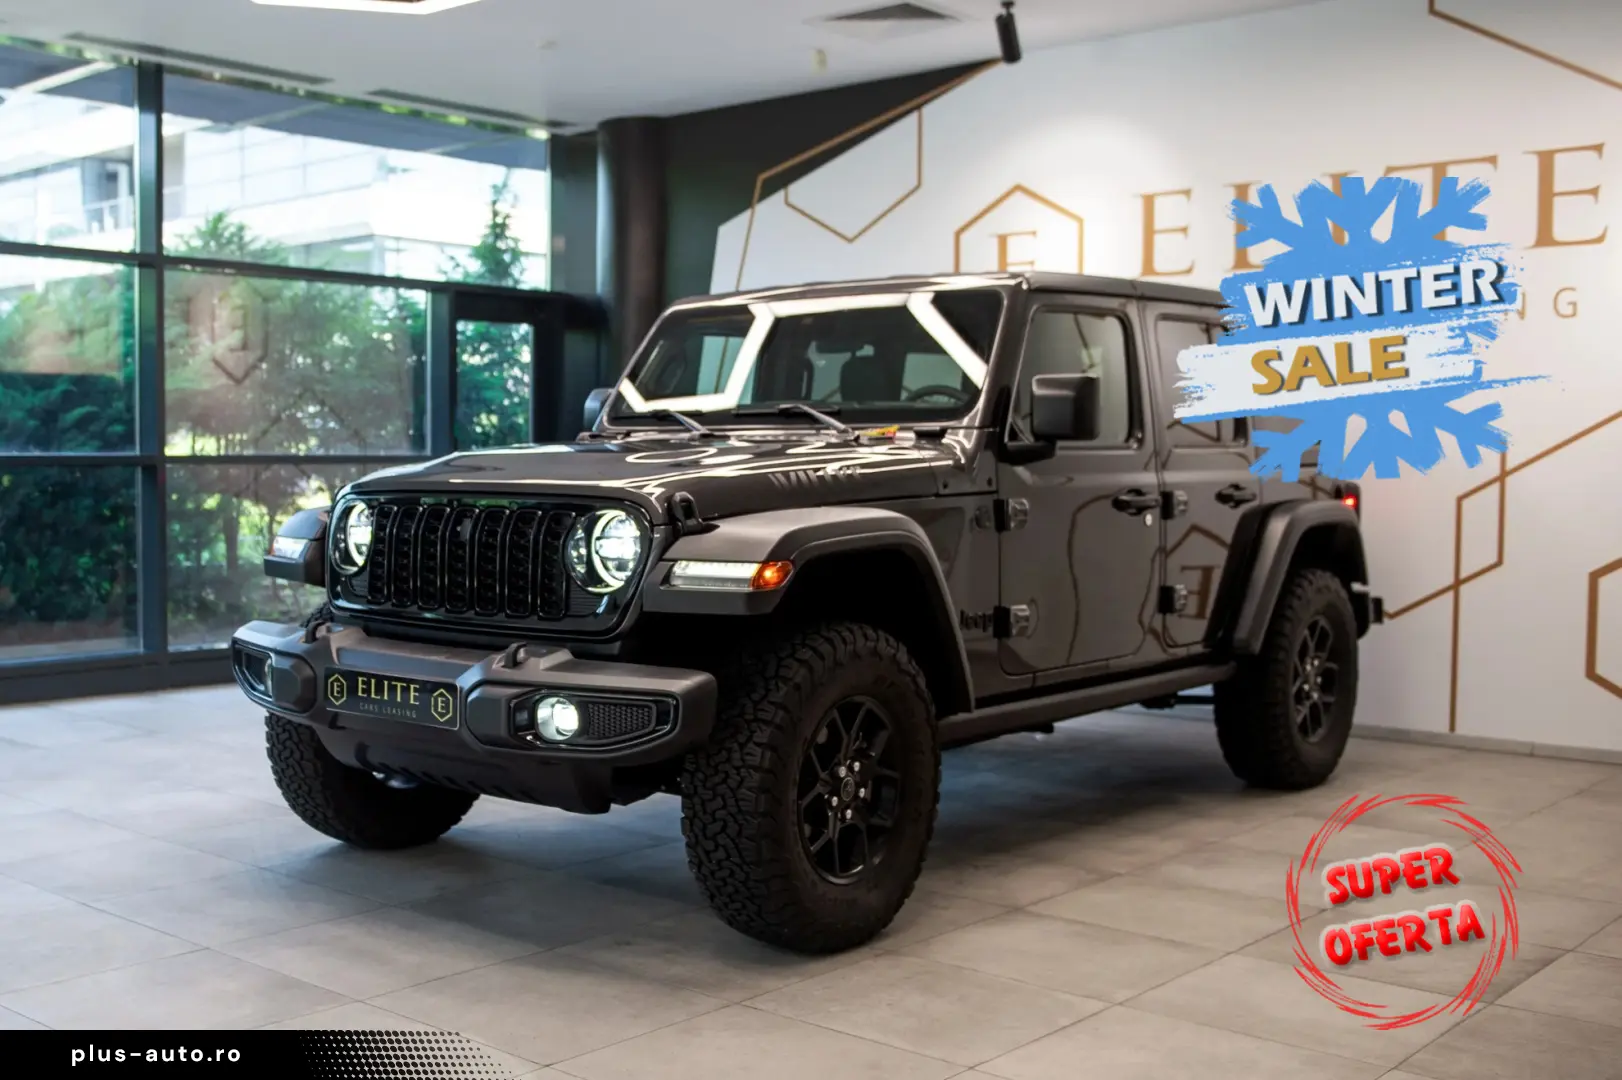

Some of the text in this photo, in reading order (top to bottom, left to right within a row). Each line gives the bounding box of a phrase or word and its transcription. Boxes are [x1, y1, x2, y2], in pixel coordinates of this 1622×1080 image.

[357, 676, 420, 705] ELITE
[359, 702, 417, 719] CARS LEASING
